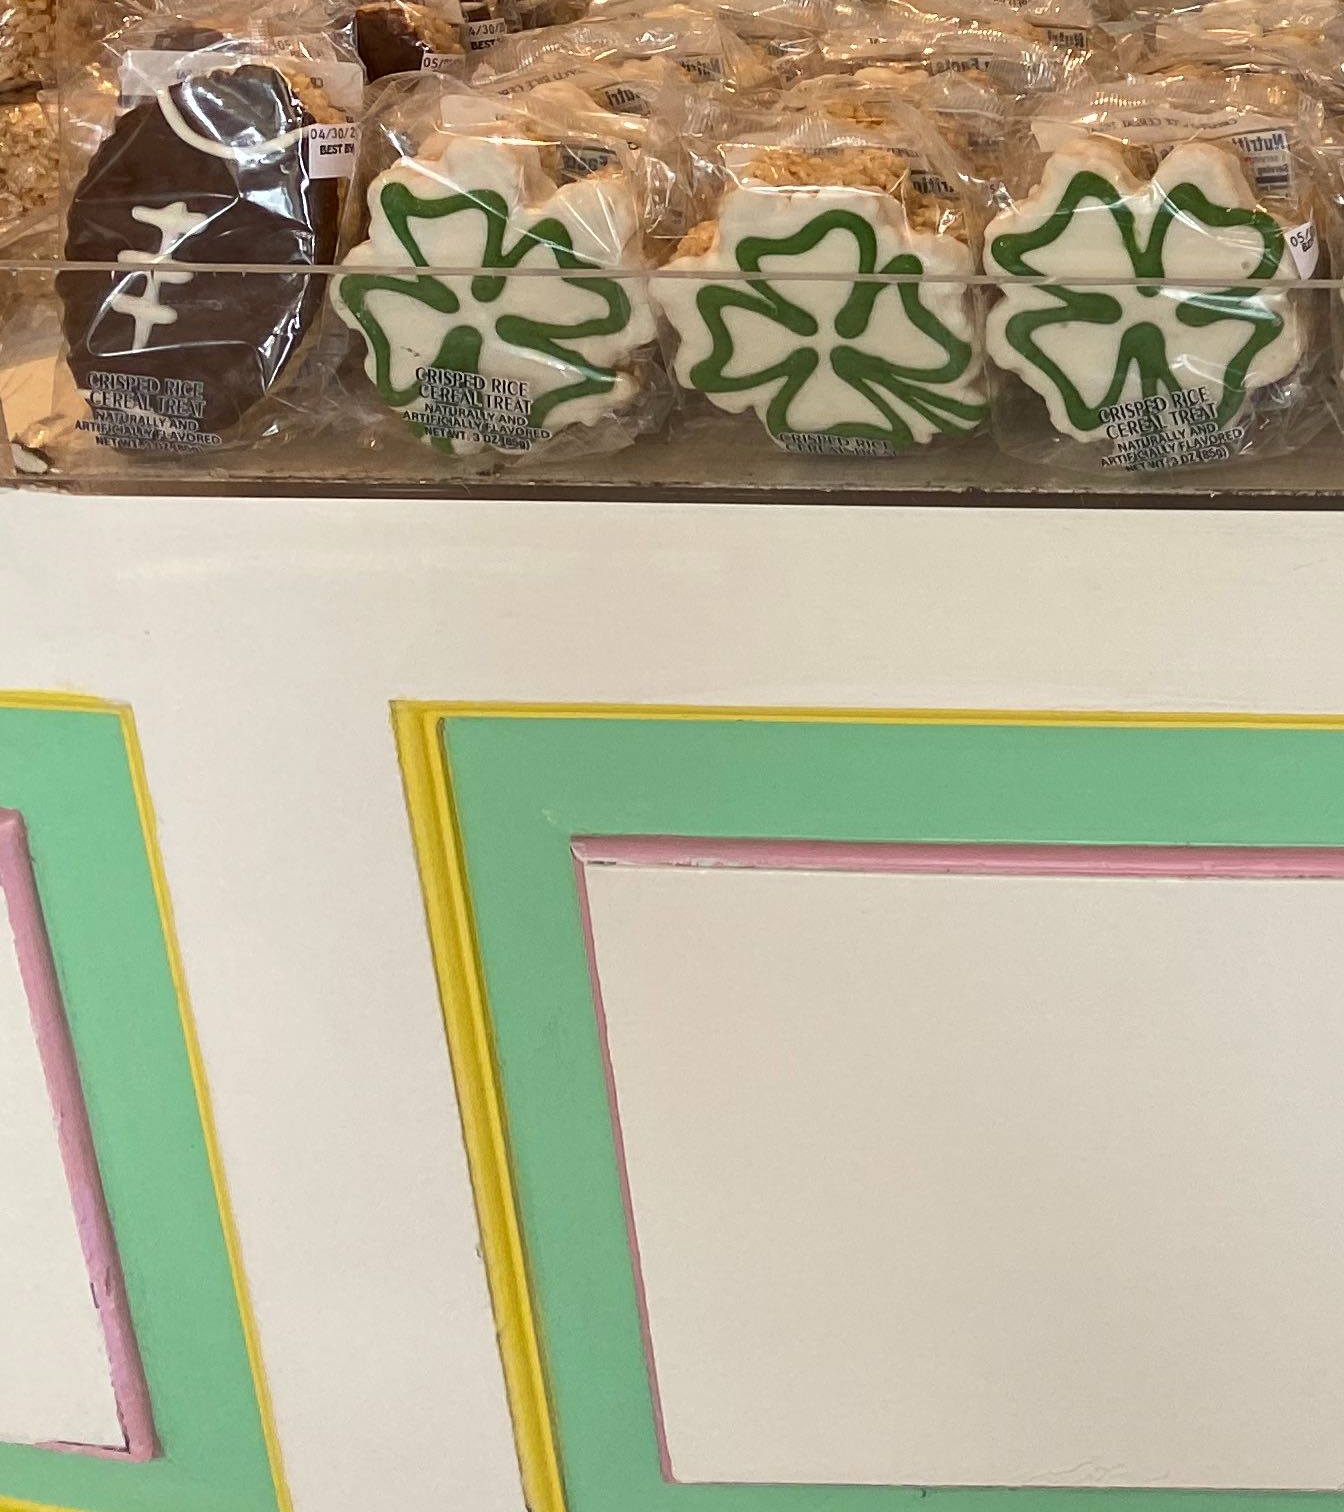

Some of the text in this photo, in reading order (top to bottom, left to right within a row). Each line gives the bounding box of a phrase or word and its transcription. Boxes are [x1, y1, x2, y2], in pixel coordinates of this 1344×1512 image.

[310, 128, 355, 140] 04/30/2
[320, 144, 342, 155] BEST
[88, 372, 204, 397] CRISPED RICE
[416, 367, 528, 396] CRISPED RICE
[90, 390, 206, 418] CEREAL TREAT
[419, 384, 533, 415] CEREAL TREAT
[1099, 386, 1210, 424] CRISPED RICE
[96, 410, 199, 431] NATURALLY AND
[402, 410, 551, 438] ARTIFICIALLY FLAVORED
[425, 403, 527, 426] NATURALLY AND
[1106, 403, 1218, 440] CEREAL TREAT
[425, 427, 499, 444] NET 3 OZ
[1101, 428, 1243, 467] ARTIFICIALLY FLAVORED
[1118, 422, 1217, 453] NATURALLY AND
